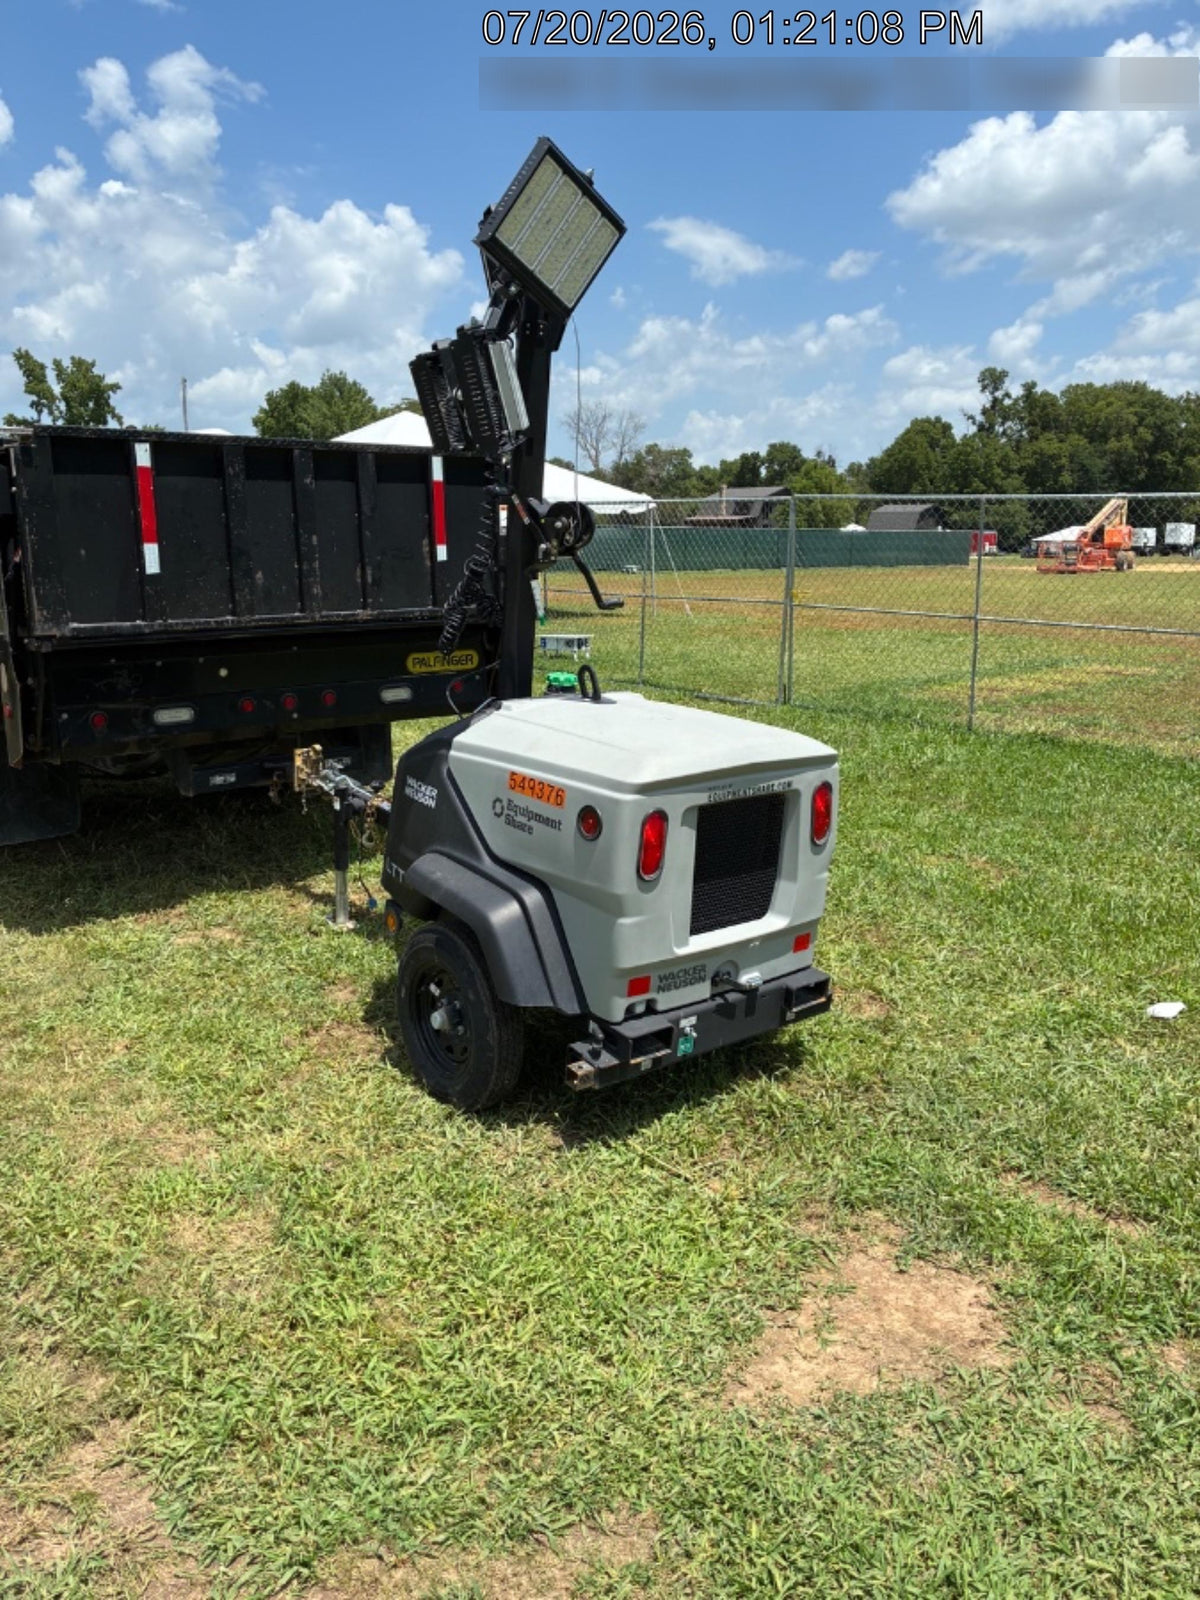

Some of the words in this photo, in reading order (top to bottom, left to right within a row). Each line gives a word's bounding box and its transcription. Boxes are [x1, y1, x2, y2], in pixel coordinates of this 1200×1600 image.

[406, 775, 438, 795] WACKER
[509, 771, 566, 806] 549376
[504, 814, 533, 835] Share
[506, 798, 562, 831] Equipment
[658, 964, 706, 983] WACKER
[657, 974, 706, 994] NEUSON
